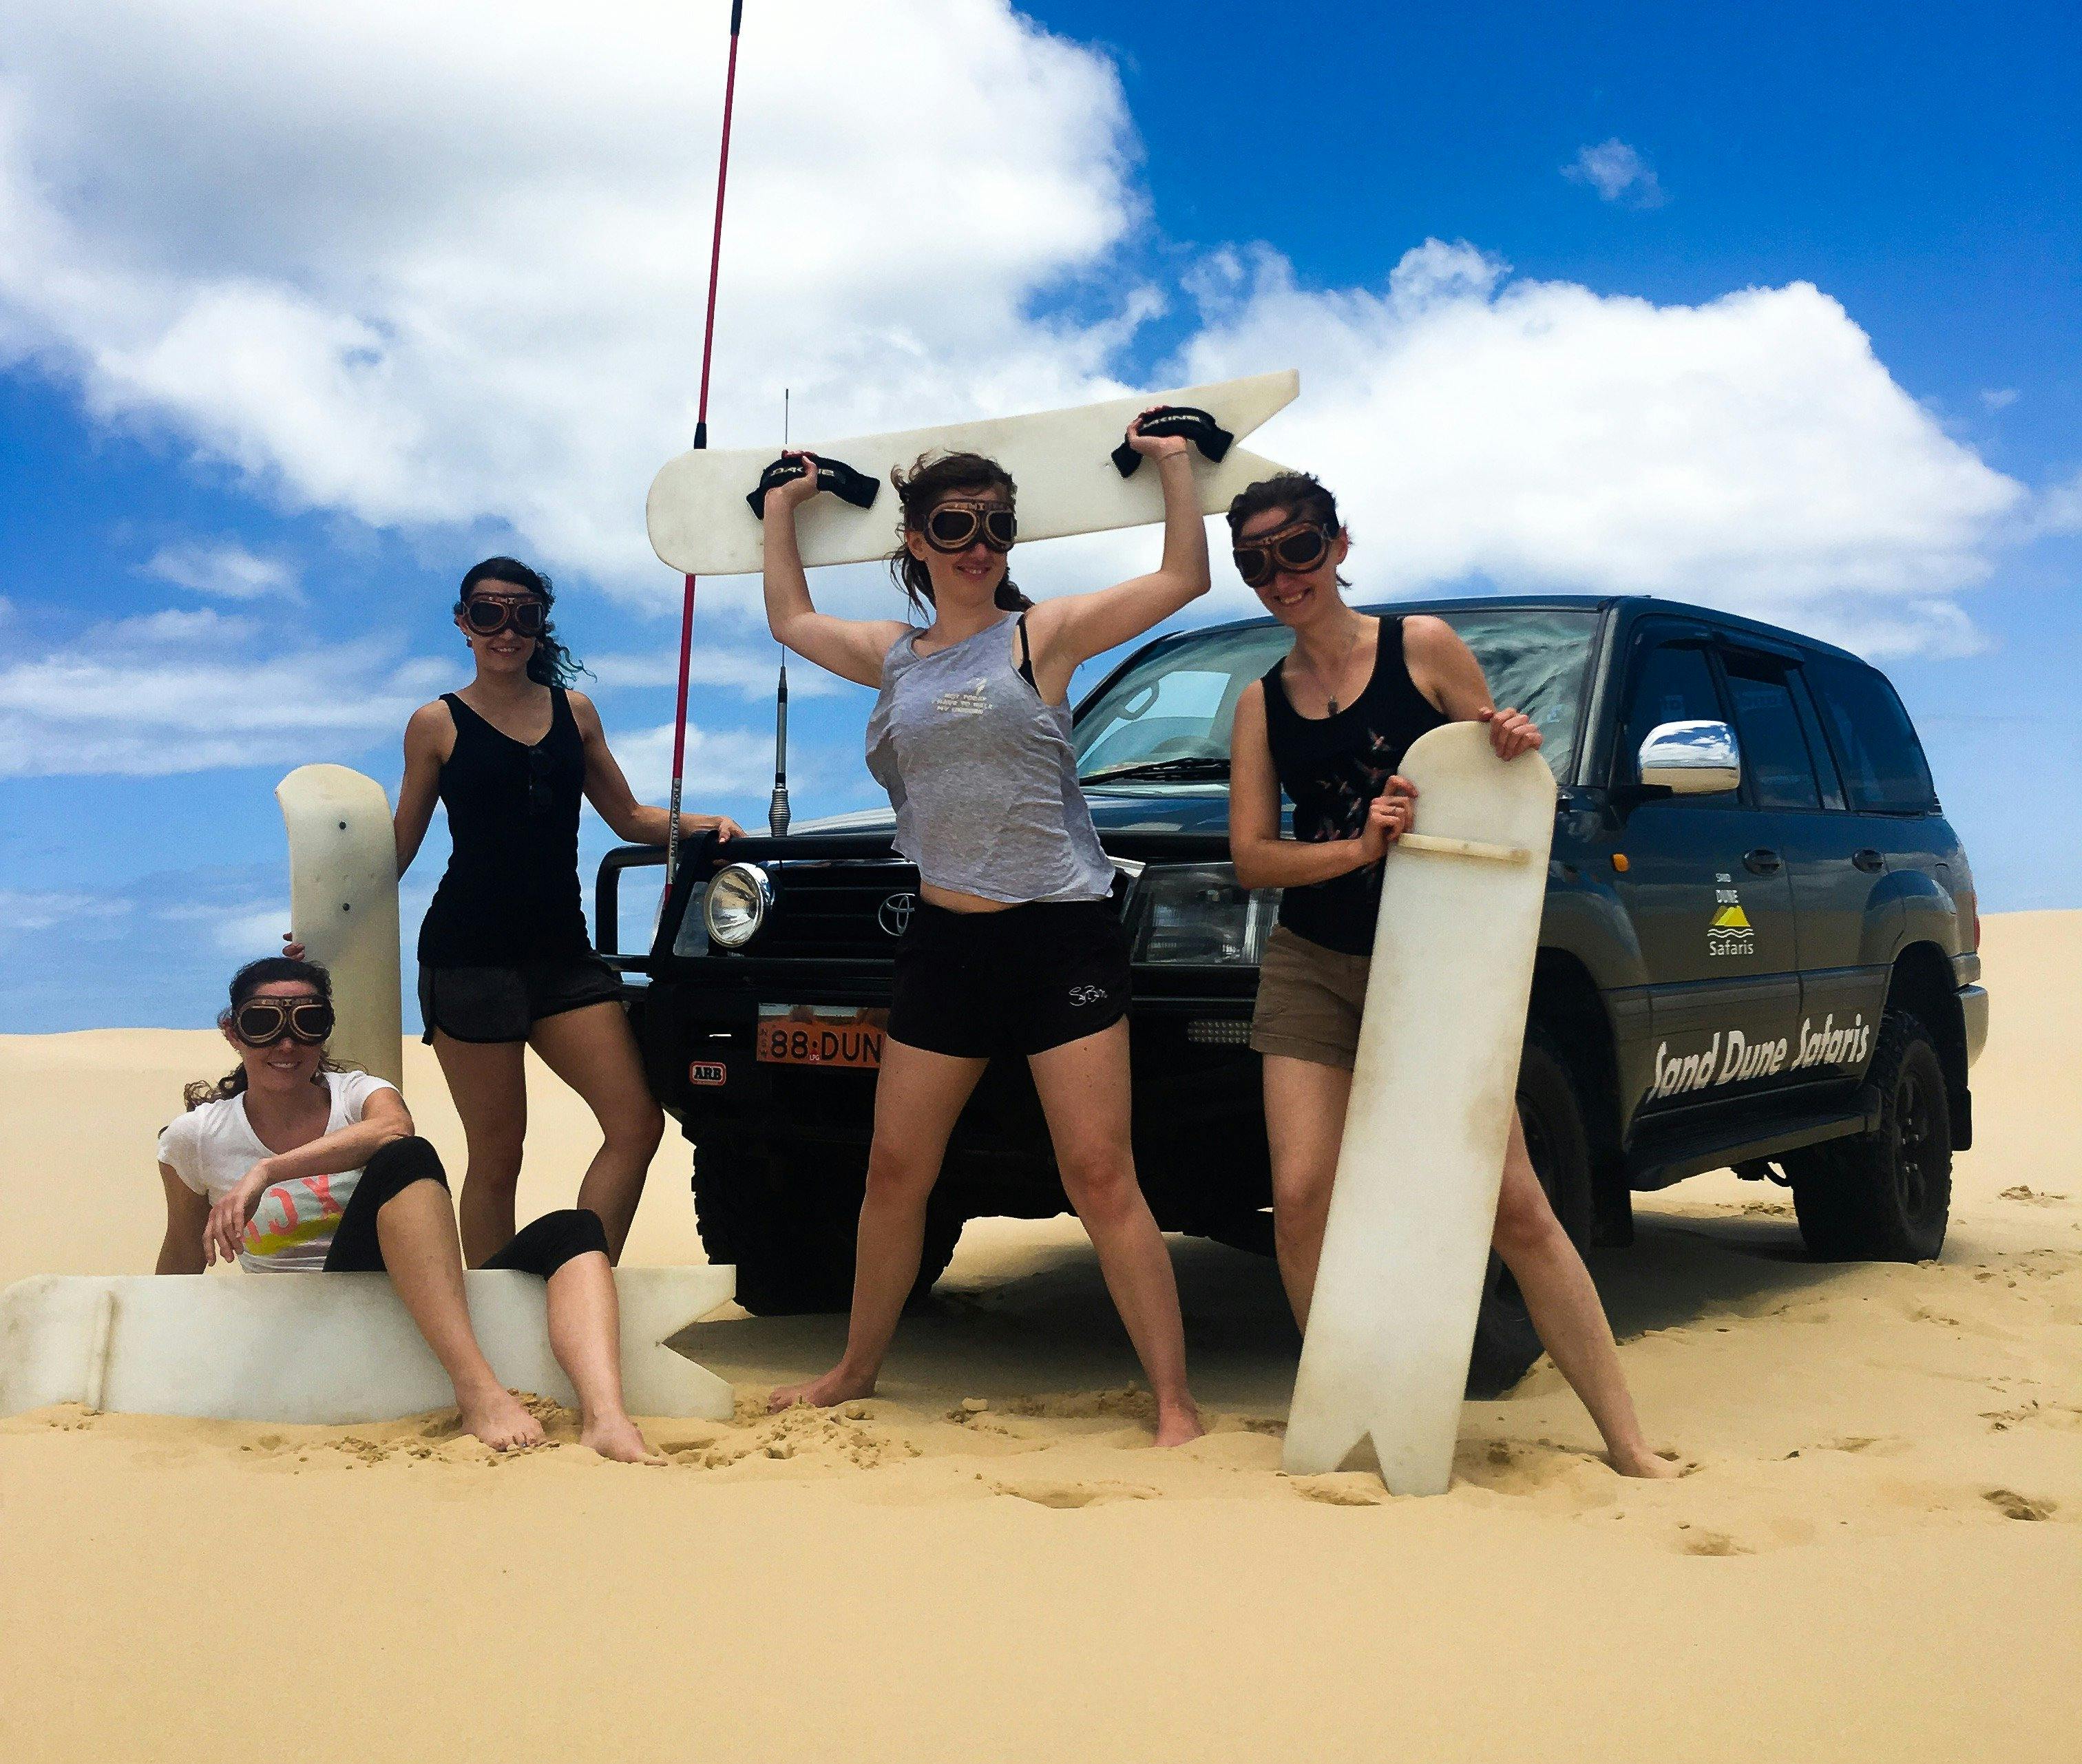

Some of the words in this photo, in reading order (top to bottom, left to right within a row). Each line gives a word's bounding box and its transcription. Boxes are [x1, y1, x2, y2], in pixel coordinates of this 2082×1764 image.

[1710, 939, 1754, 956] Safaris
[1645, 1031, 1721, 1104] Sand
[1715, 1030, 1788, 1086] Dune
[1790, 1014, 1870, 1071] Safaris
[693, 1066, 722, 1080] ARB
